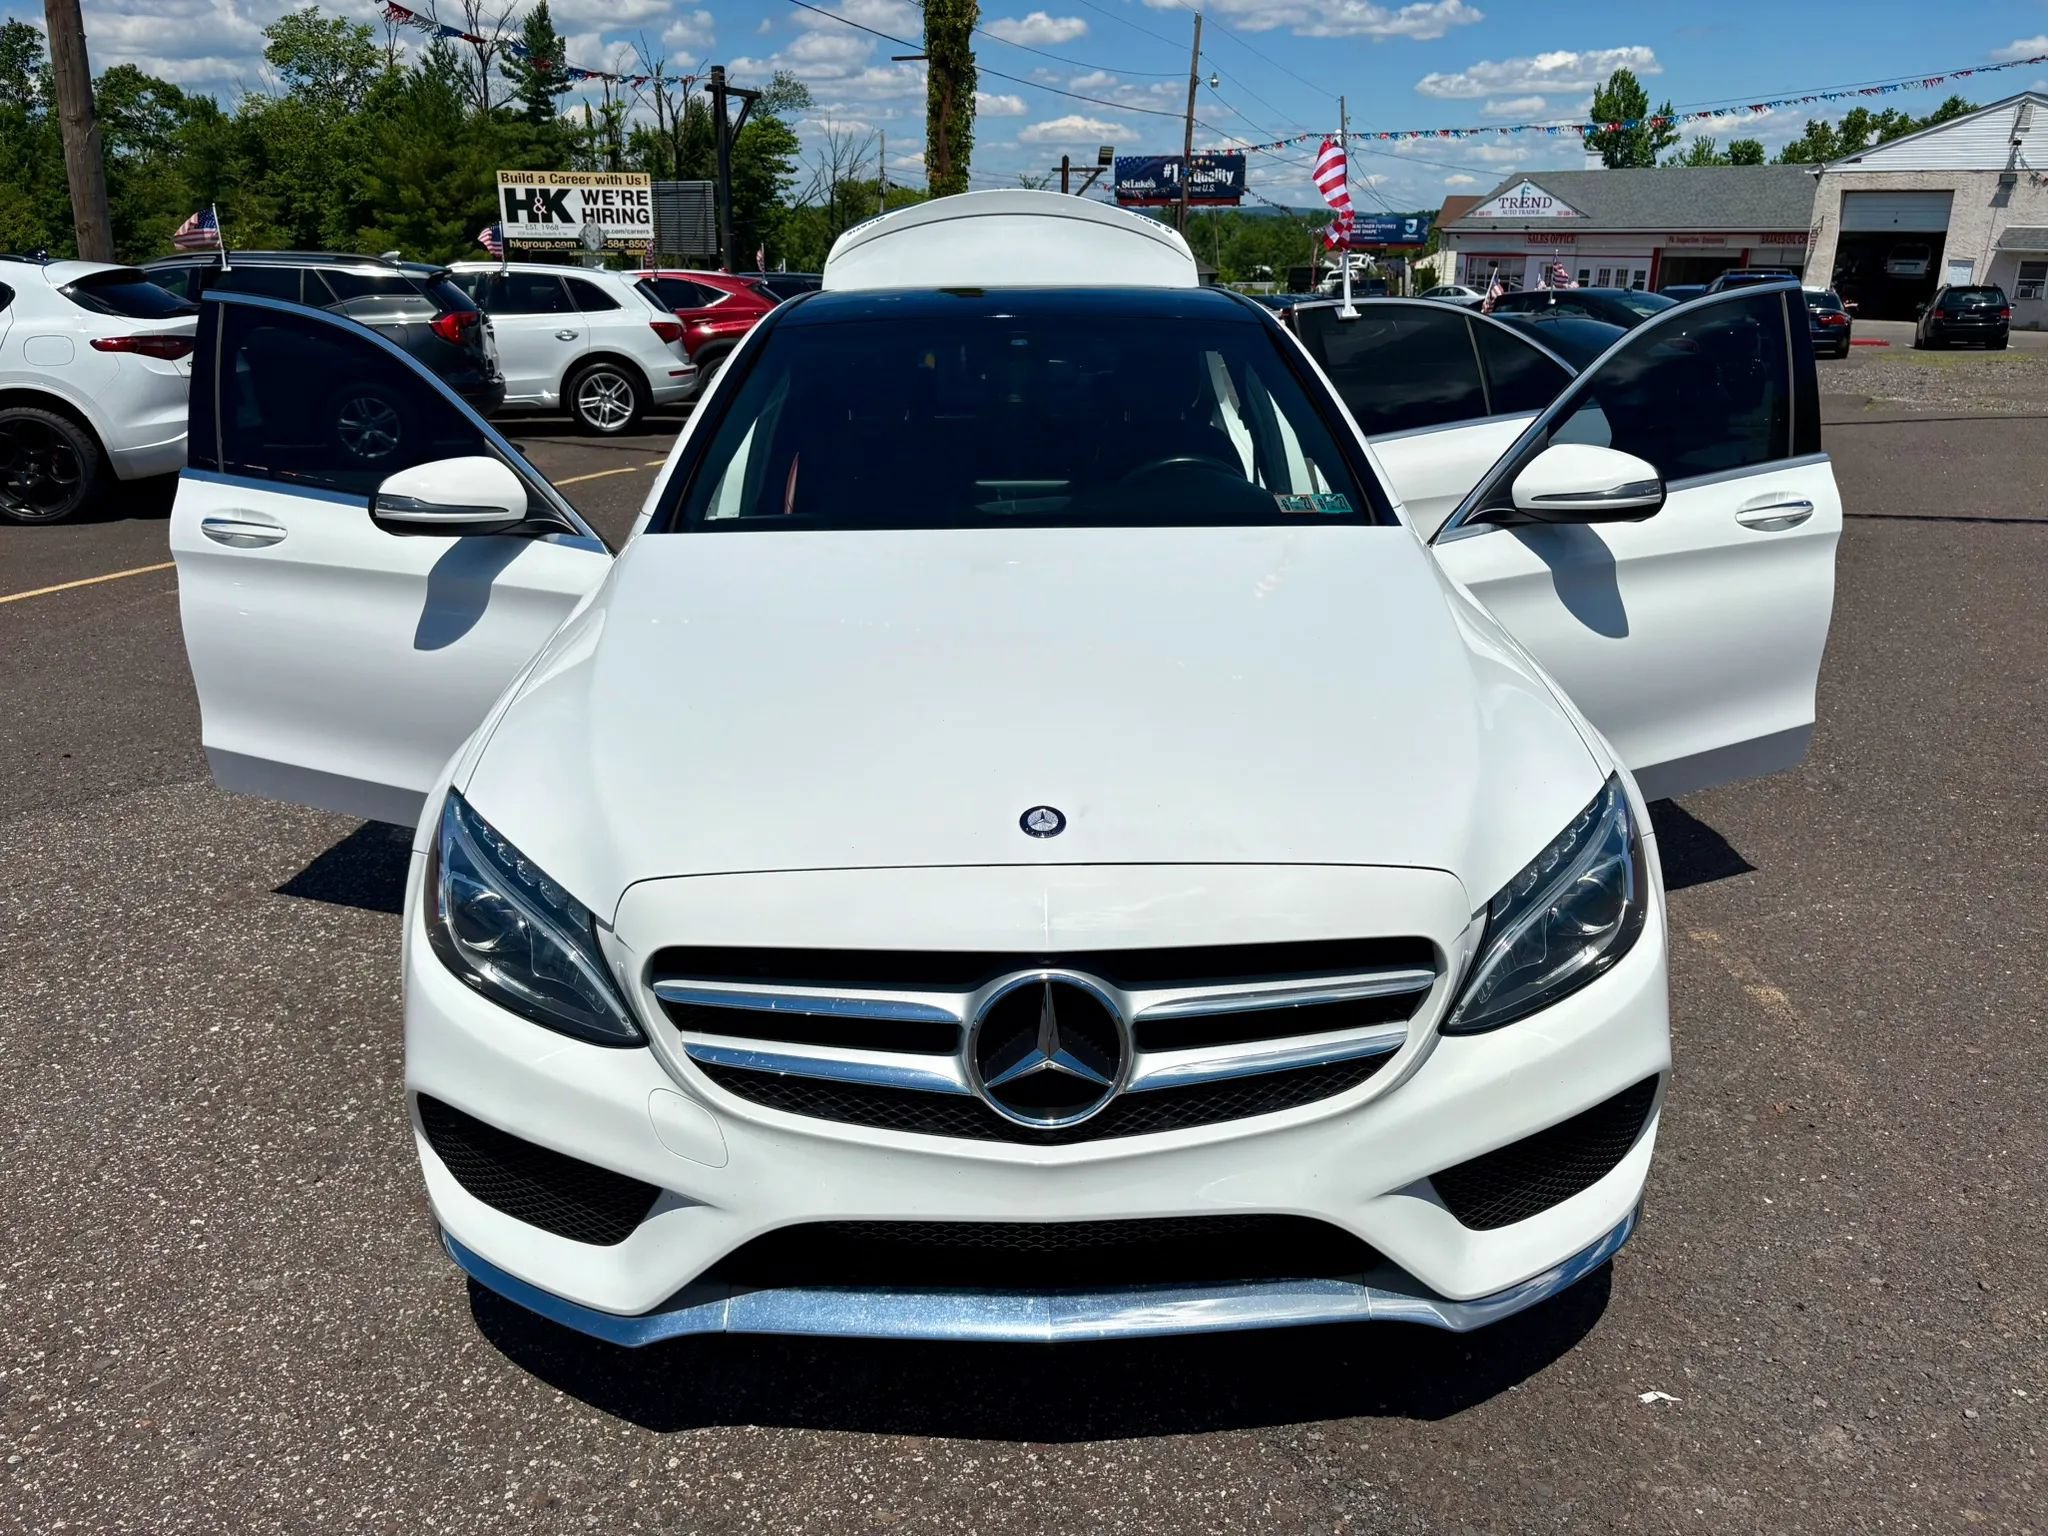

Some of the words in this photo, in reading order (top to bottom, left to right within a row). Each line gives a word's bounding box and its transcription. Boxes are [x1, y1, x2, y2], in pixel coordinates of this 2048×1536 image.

[501, 172, 534, 184] Build
[538, 175, 546, 184] a
[549, 173, 591, 185] Career
[595, 174, 622, 185] with
[1163, 163, 1179, 183] #1
[580, 189, 649, 206] WE'RE
[1498, 197, 1553, 209] TREND
[581, 208, 650, 224] HIRING
[509, 240, 577, 250] hkgroup.com
[1527, 234, 1549, 245] SALES
[1550, 233, 1577, 244] OFFICE
